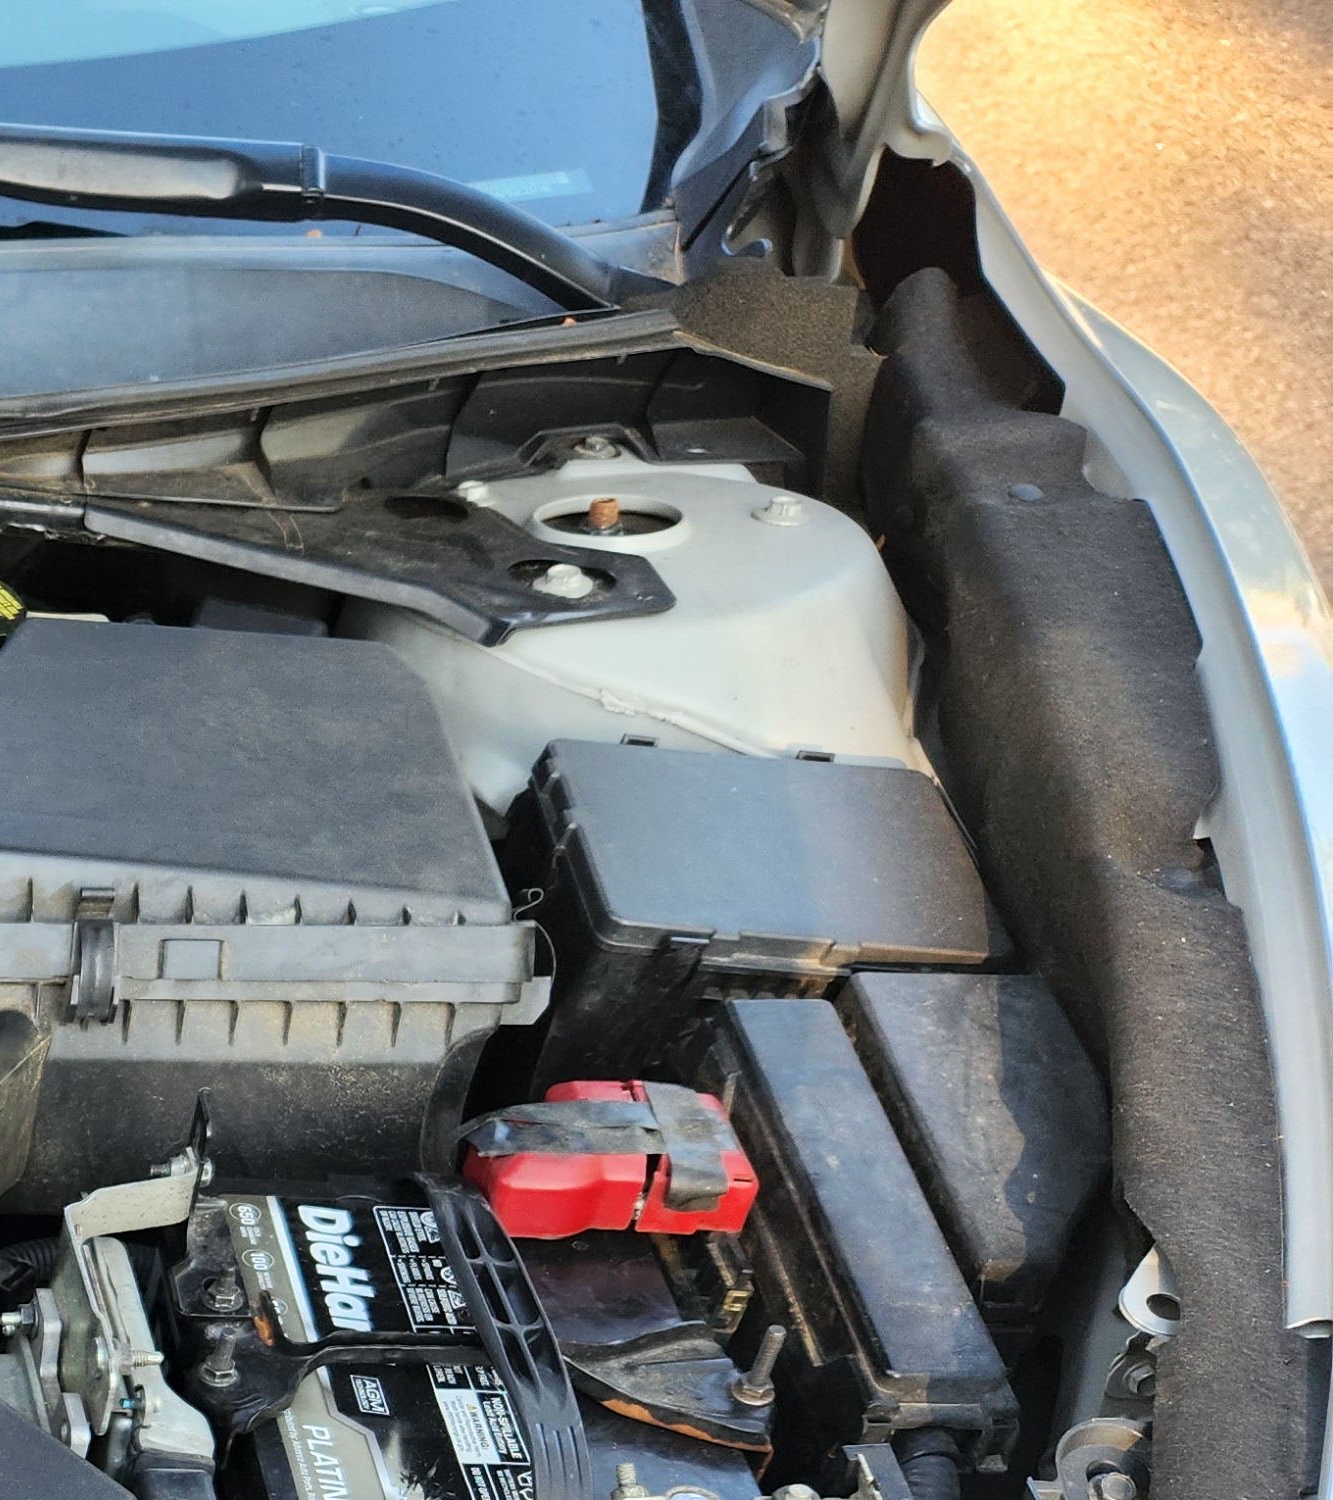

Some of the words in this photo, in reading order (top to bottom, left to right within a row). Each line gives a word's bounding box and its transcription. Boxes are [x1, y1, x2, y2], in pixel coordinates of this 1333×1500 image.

[238, 1205, 255, 1225] 650
[250, 1253, 268, 1270] 100
[298, 1205, 375, 1332] DieHar
[363, 1379, 385, 1412] AGM
[490, 1397, 523, 1460] NON-SPILLABLE
